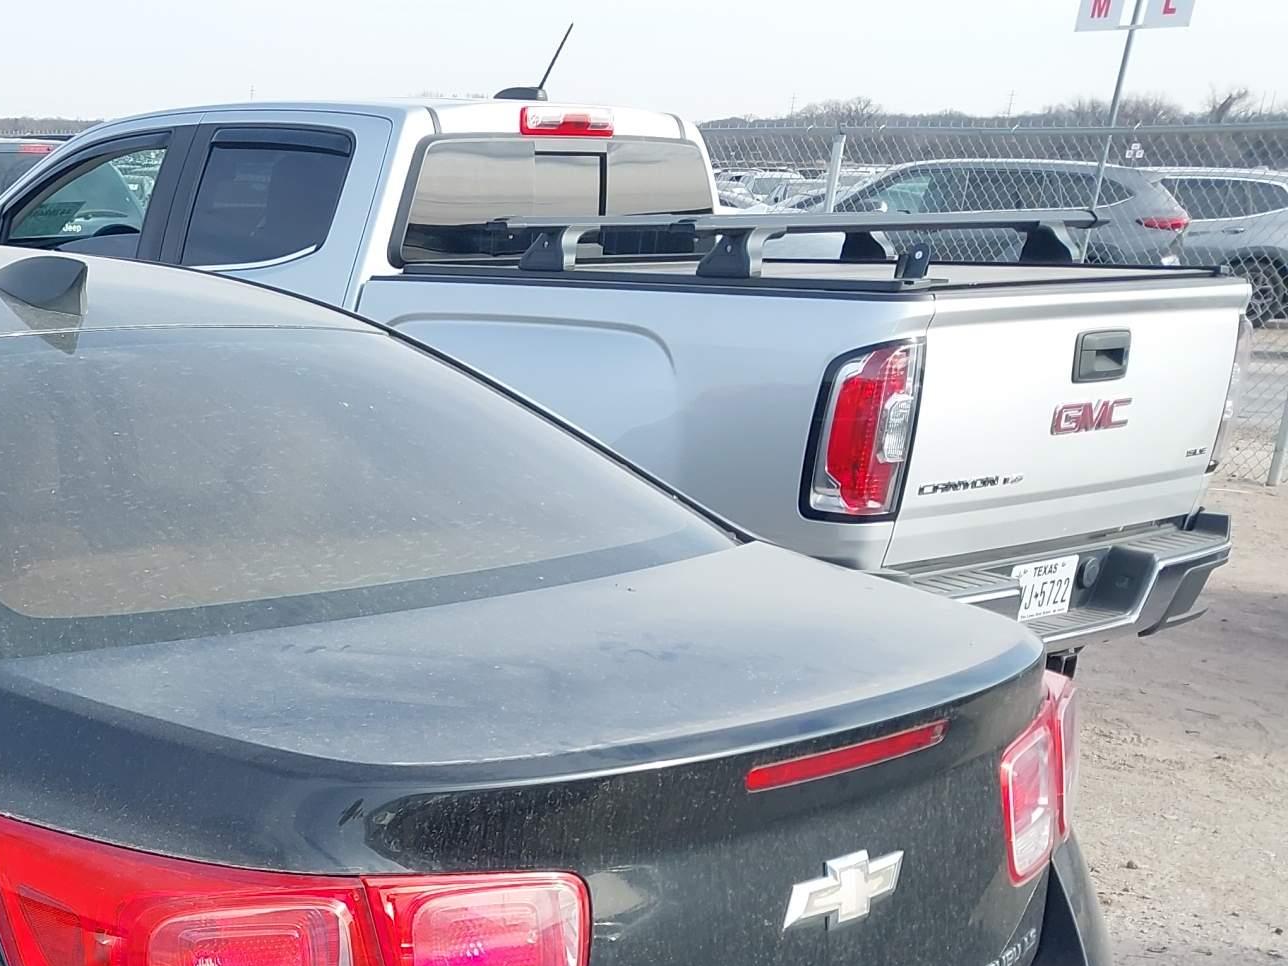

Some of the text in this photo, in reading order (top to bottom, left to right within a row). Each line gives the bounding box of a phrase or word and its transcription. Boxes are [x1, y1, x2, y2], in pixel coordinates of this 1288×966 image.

[62, 222, 82, 232] Jeep
[1050, 398, 1132, 435] GMC
[917, 476, 999, 495] CANYON
[1033, 562, 1059, 577] TEXAS
